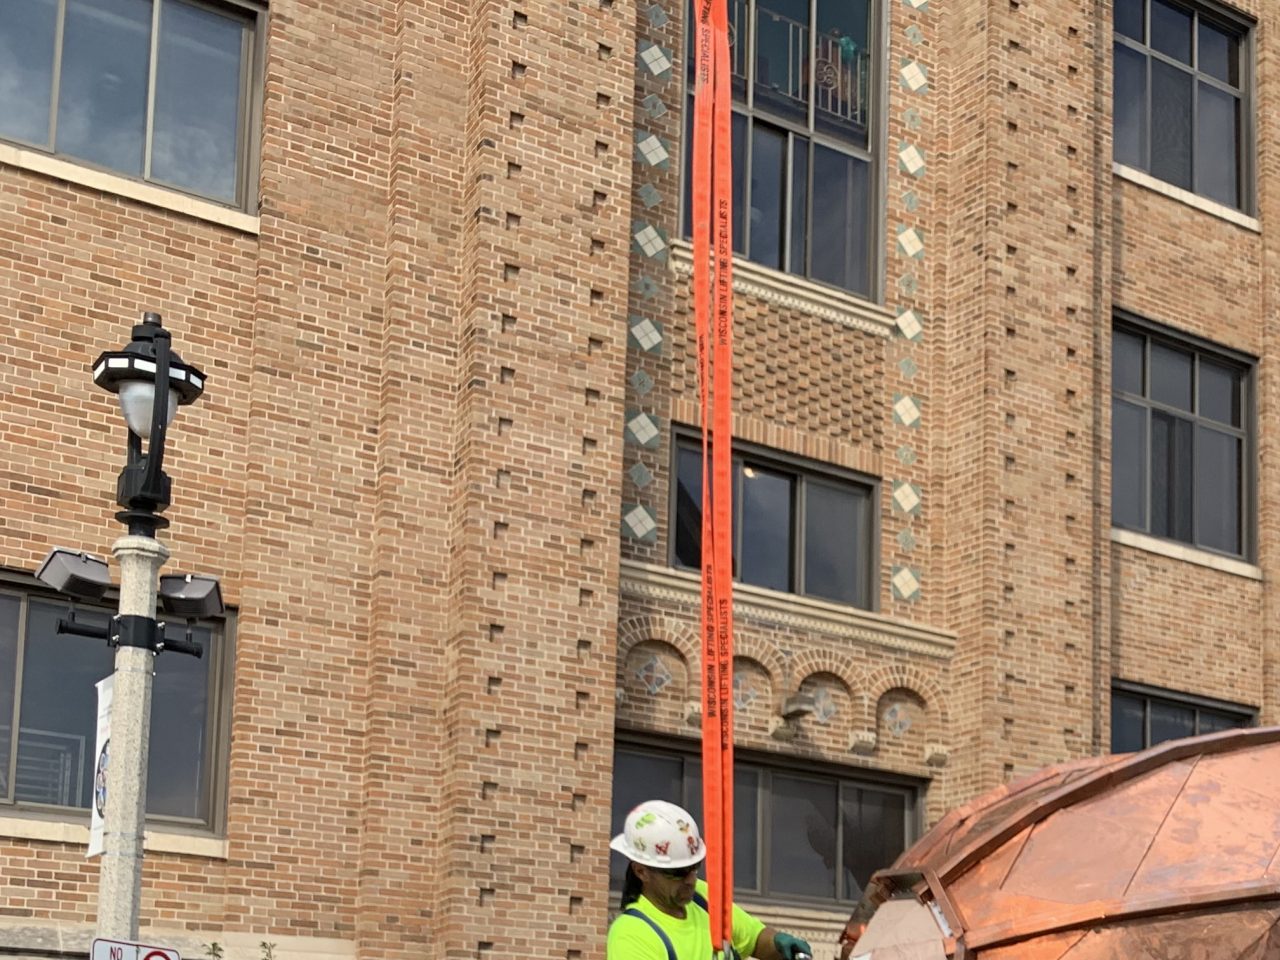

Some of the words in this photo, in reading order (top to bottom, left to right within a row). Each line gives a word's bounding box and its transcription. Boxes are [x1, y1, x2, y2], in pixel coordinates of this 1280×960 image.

[719, 199, 728, 256] SPECIALISTS
[719, 259, 728, 291] LIFTING
[719, 295, 728, 346] WISCONSIN
[706, 564, 714, 623] SPECIALISTS
[706, 625, 715, 662] LIFTING
[719, 598, 729, 657] SPECIALISTS
[706, 664, 716, 718] WISCONSIN
[720, 660, 729, 695] LIFTING
